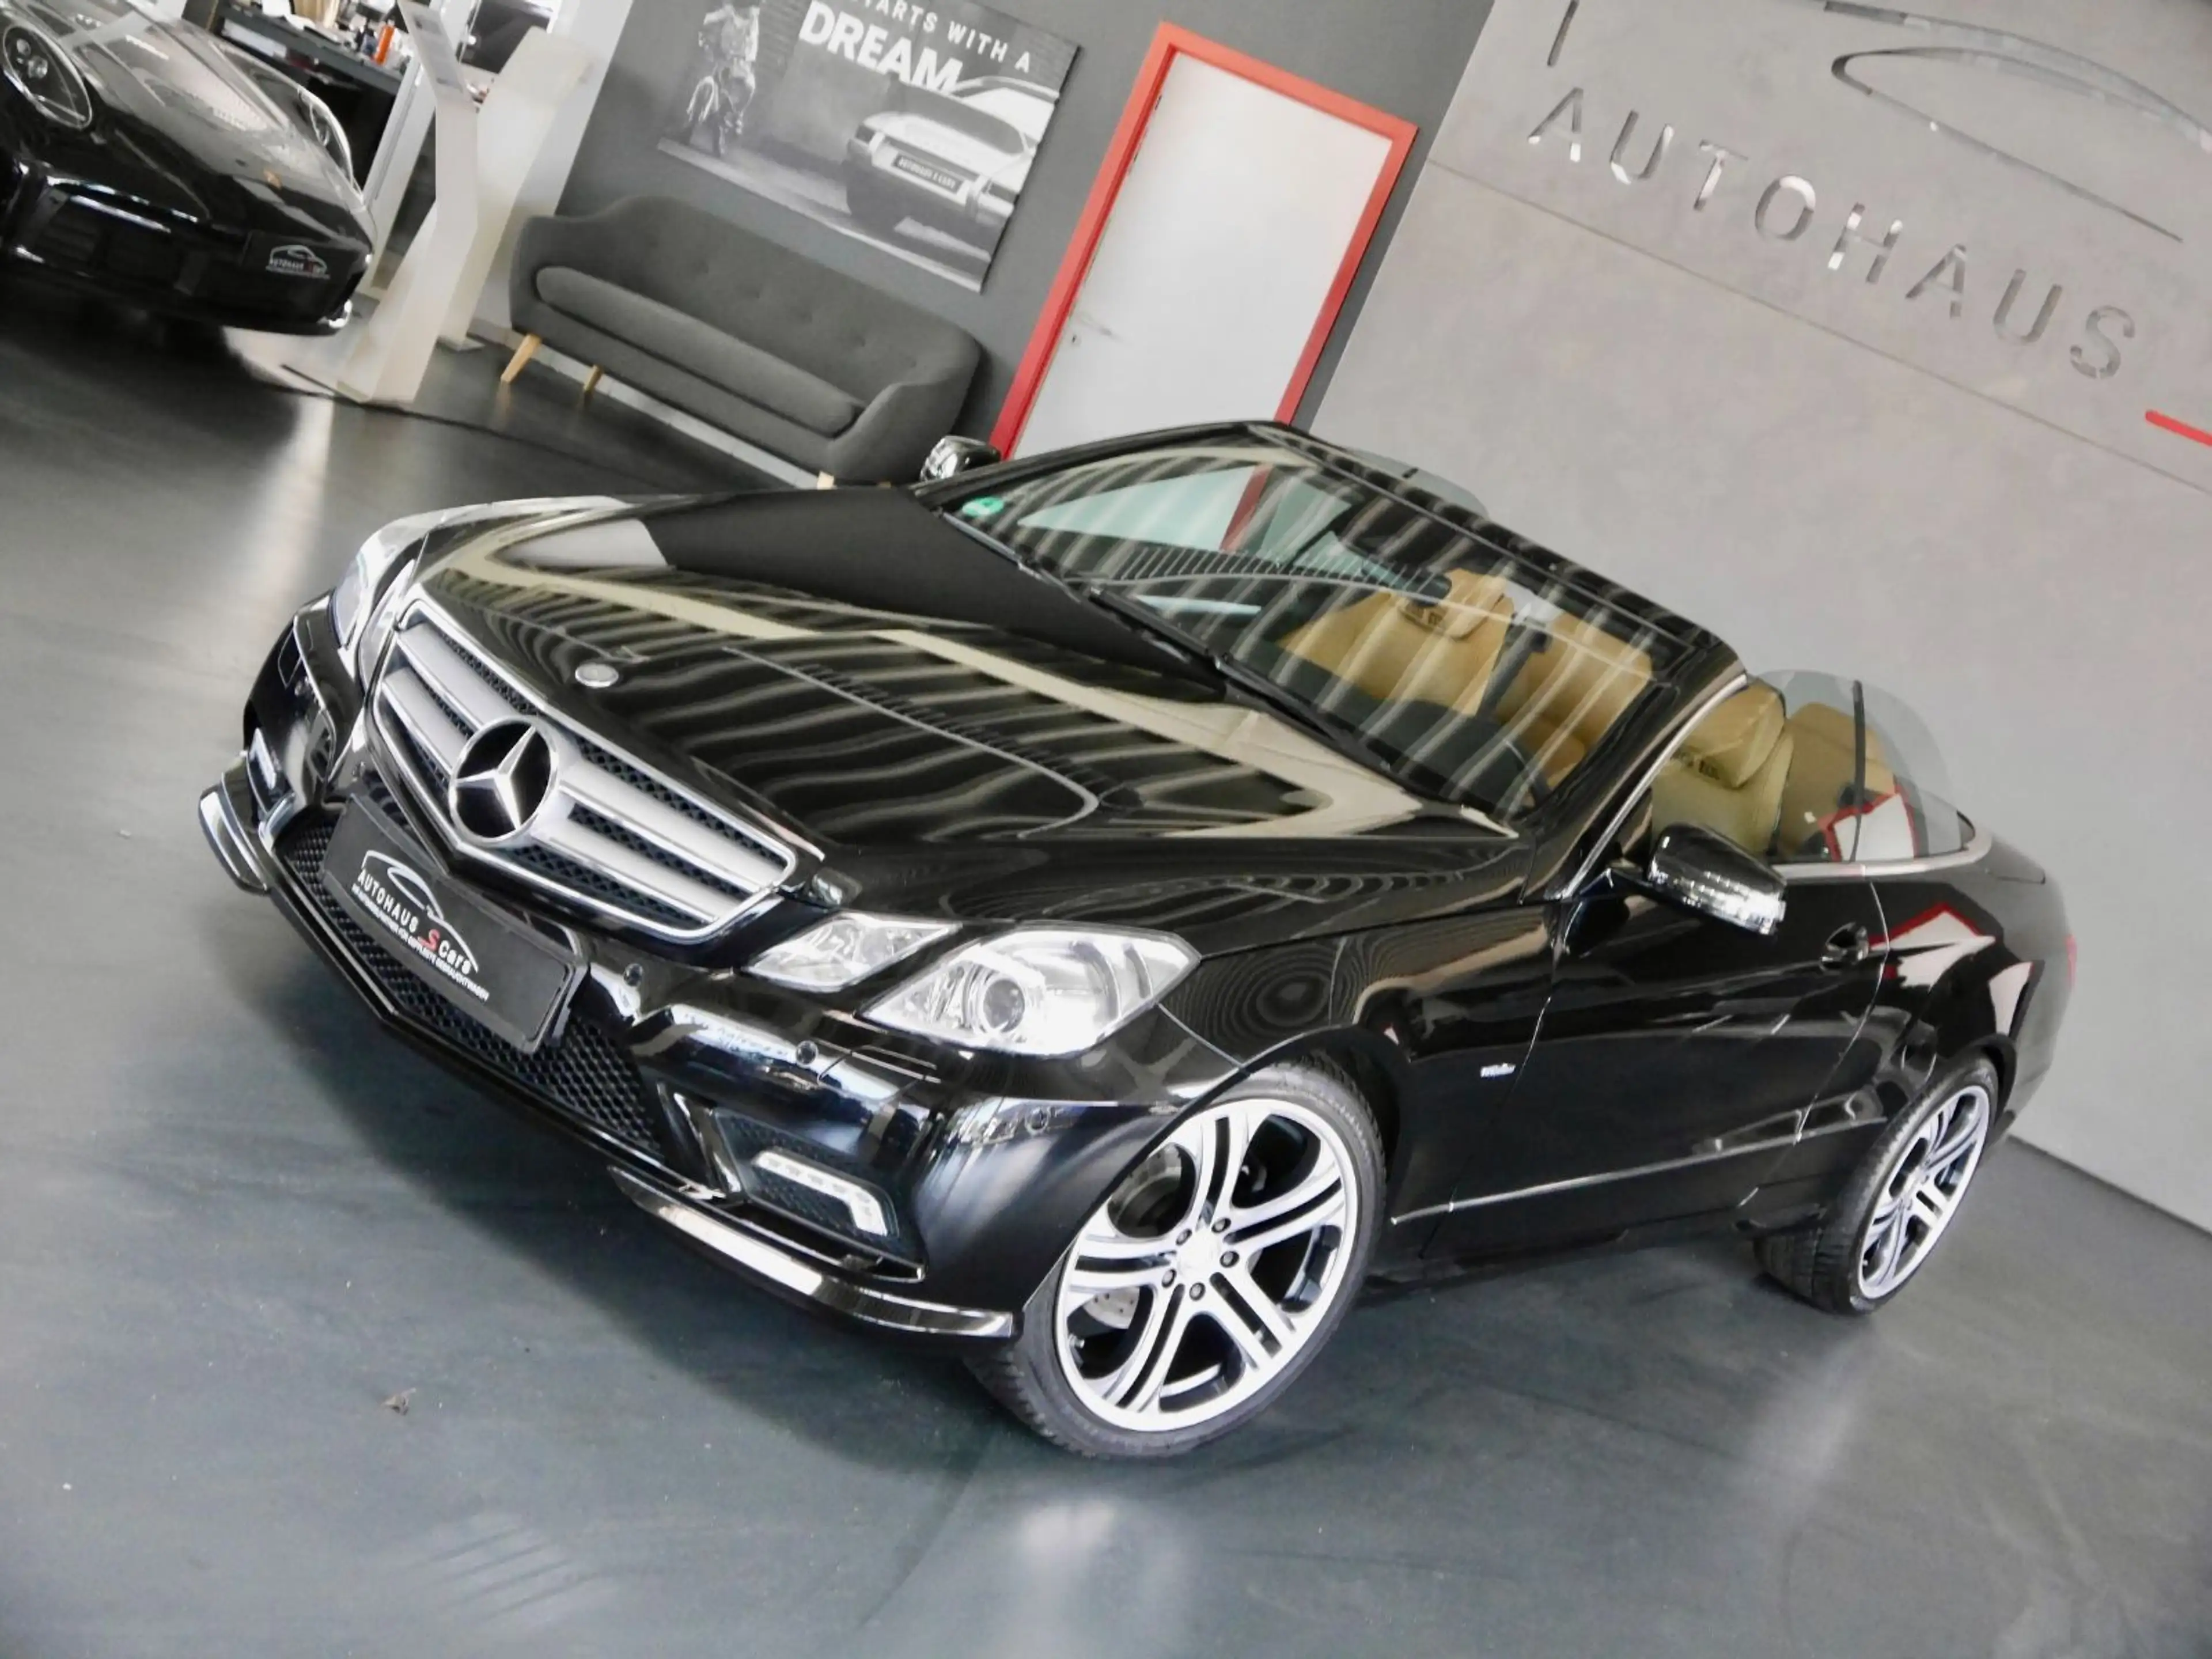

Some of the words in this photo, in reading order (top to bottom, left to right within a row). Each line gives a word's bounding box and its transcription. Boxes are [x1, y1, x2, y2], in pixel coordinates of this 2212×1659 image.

[799, 0, 963, 93] DREAM
[948, 21, 1009, 63] WITH
[1016, 51, 1031, 73] A
[1527, 86, 2136, 379] AUTOHAUS
[357, 869, 419, 933] AUTOHAUS
[416, 929, 441, 952] S
[438, 940, 472, 975] Cars
